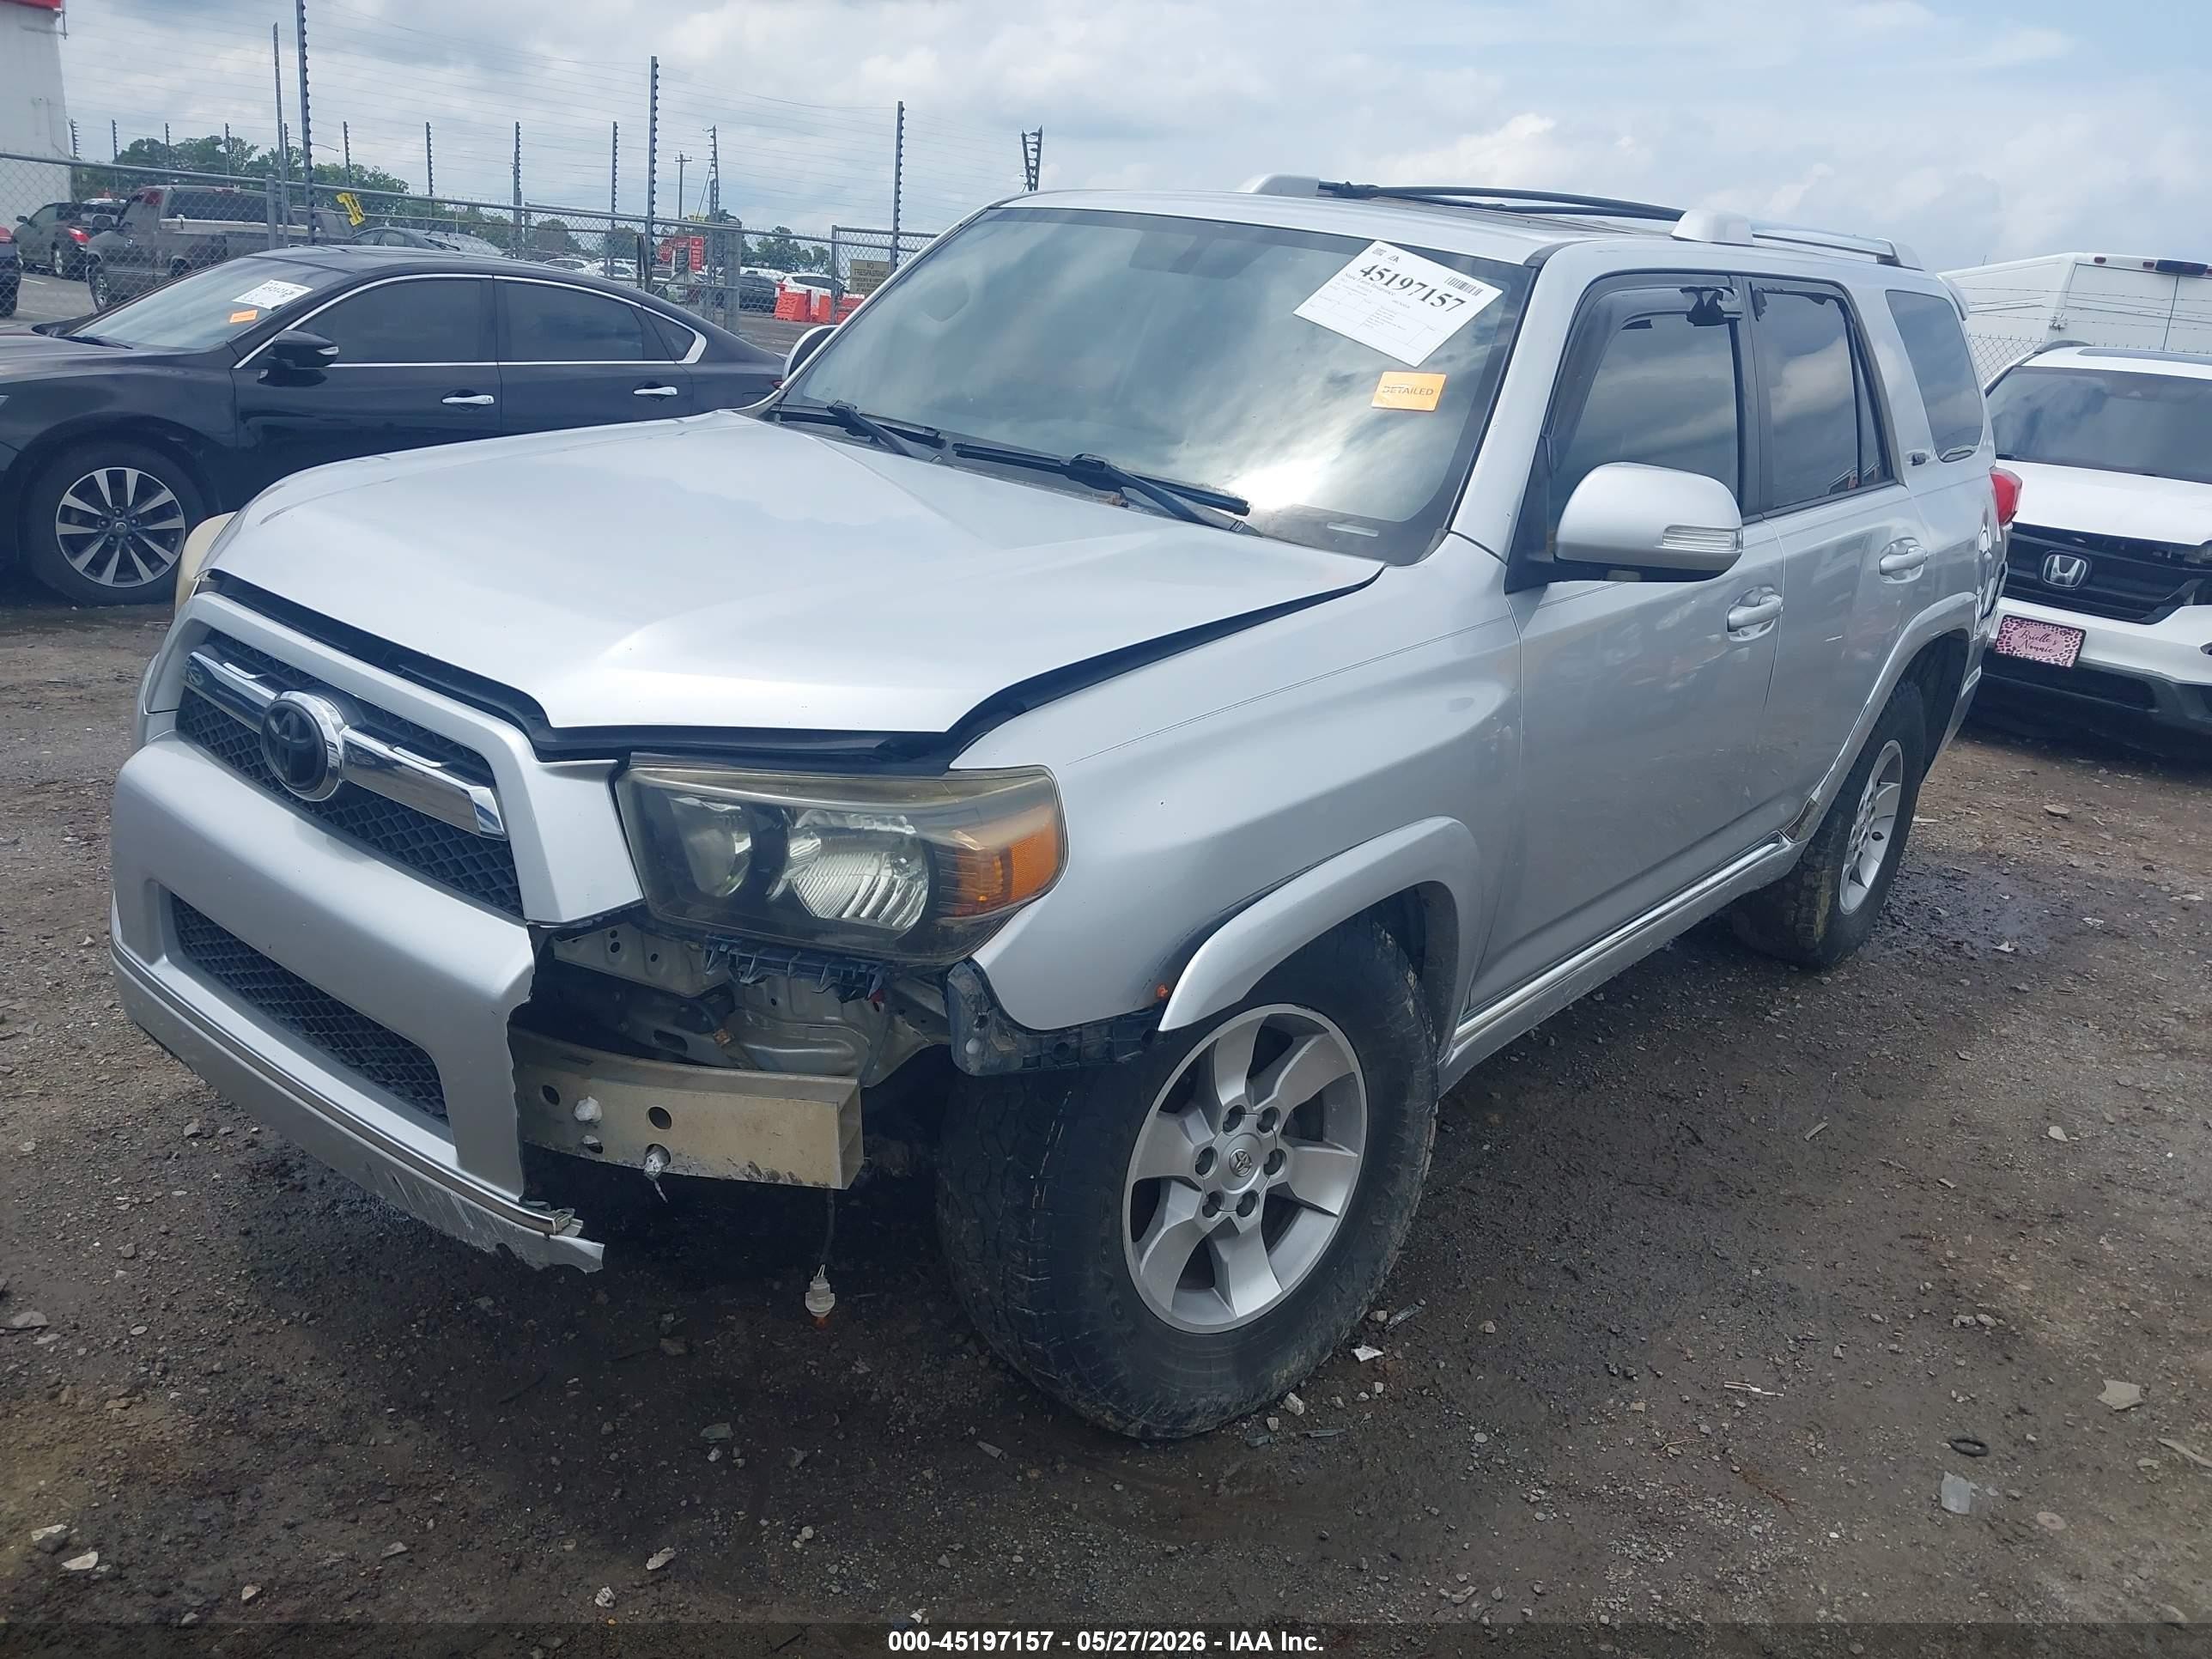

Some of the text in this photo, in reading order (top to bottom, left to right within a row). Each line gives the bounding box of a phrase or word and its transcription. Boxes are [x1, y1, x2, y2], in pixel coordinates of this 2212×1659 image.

[659, 246, 672, 254] STOP
[1359, 264, 1467, 312] 45197157
[1382, 386, 1434, 396] DETAILED
